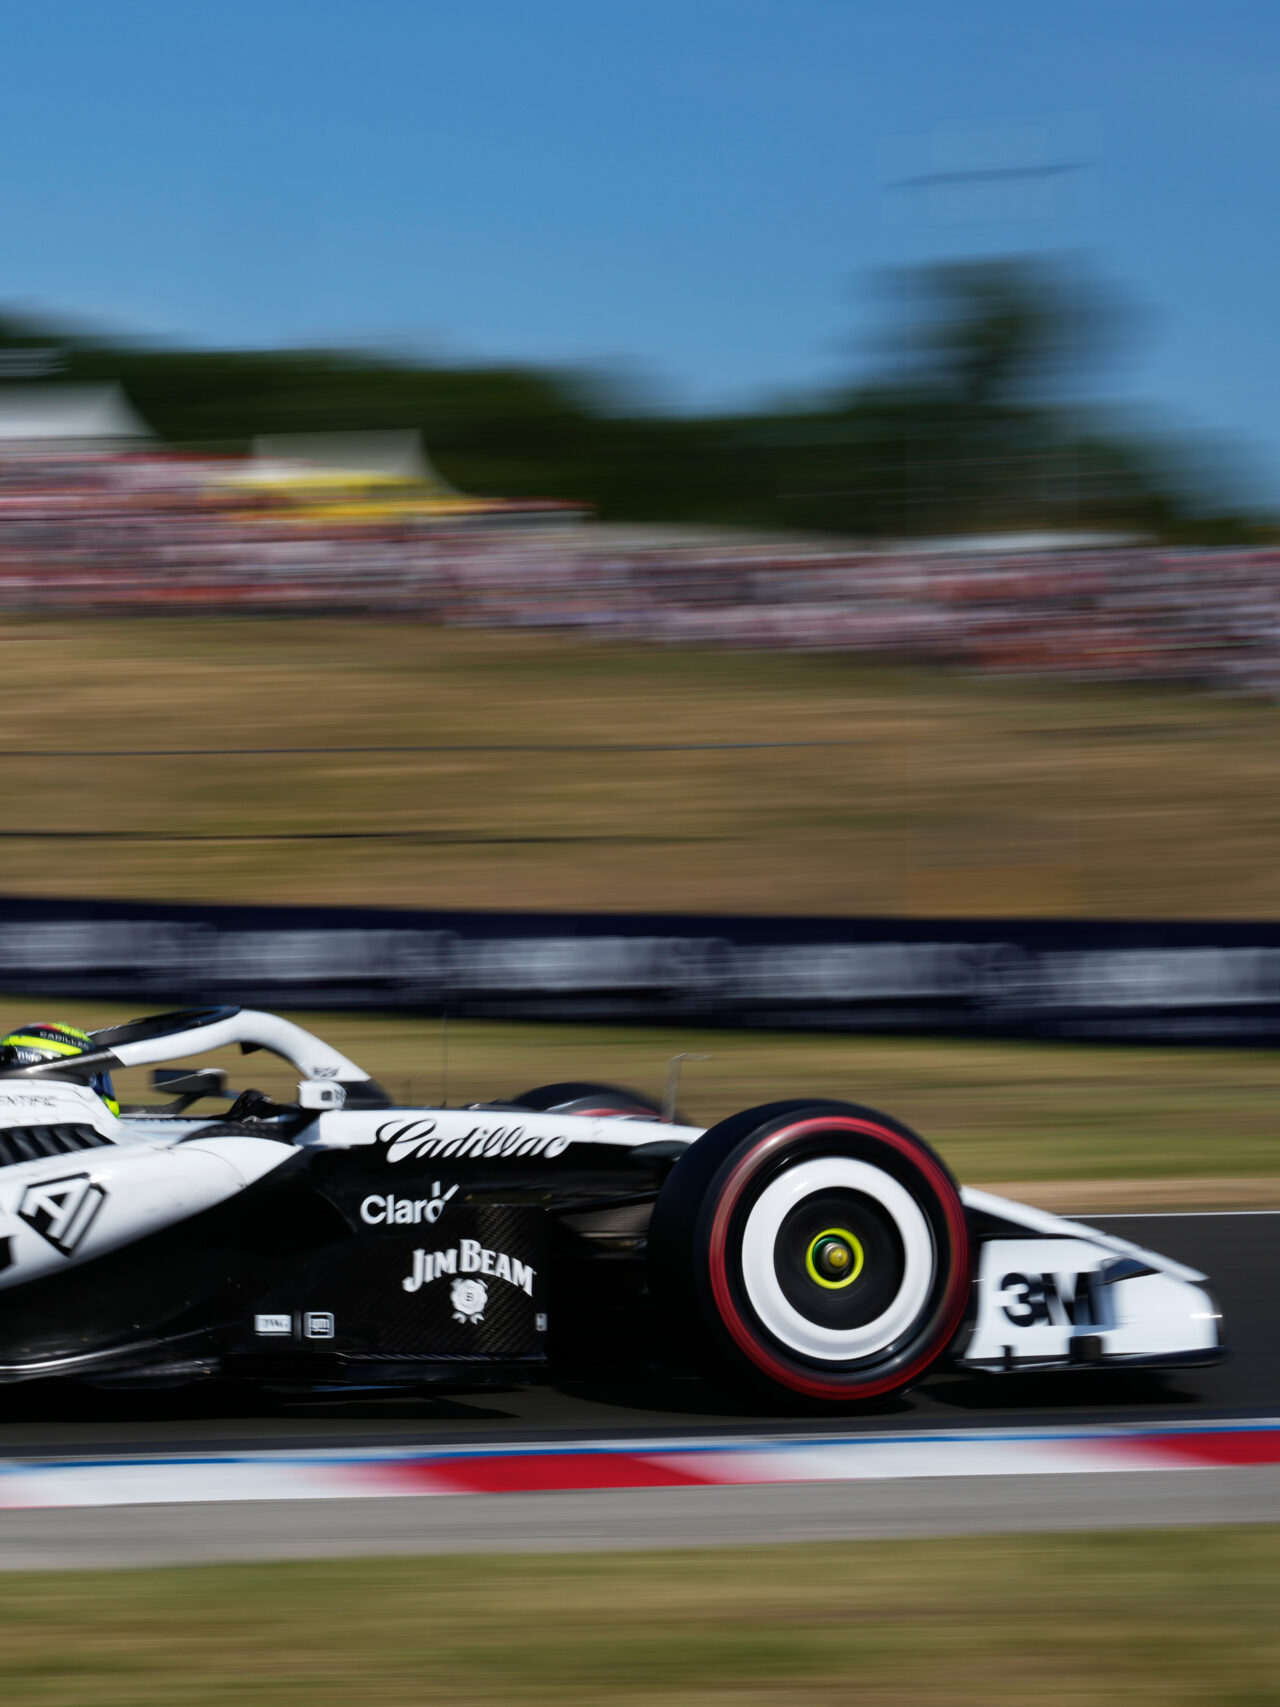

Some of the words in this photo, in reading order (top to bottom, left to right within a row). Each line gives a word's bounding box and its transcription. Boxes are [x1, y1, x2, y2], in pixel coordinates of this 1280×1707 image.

[375, 1118, 570, 1163] Cadillac
[360, 1181, 460, 1225] Claro
[402, 1249, 458, 1292] JIM
[459, 1239, 535, 1297] BEAM
[1000, 1272, 1114, 1328] 3M
